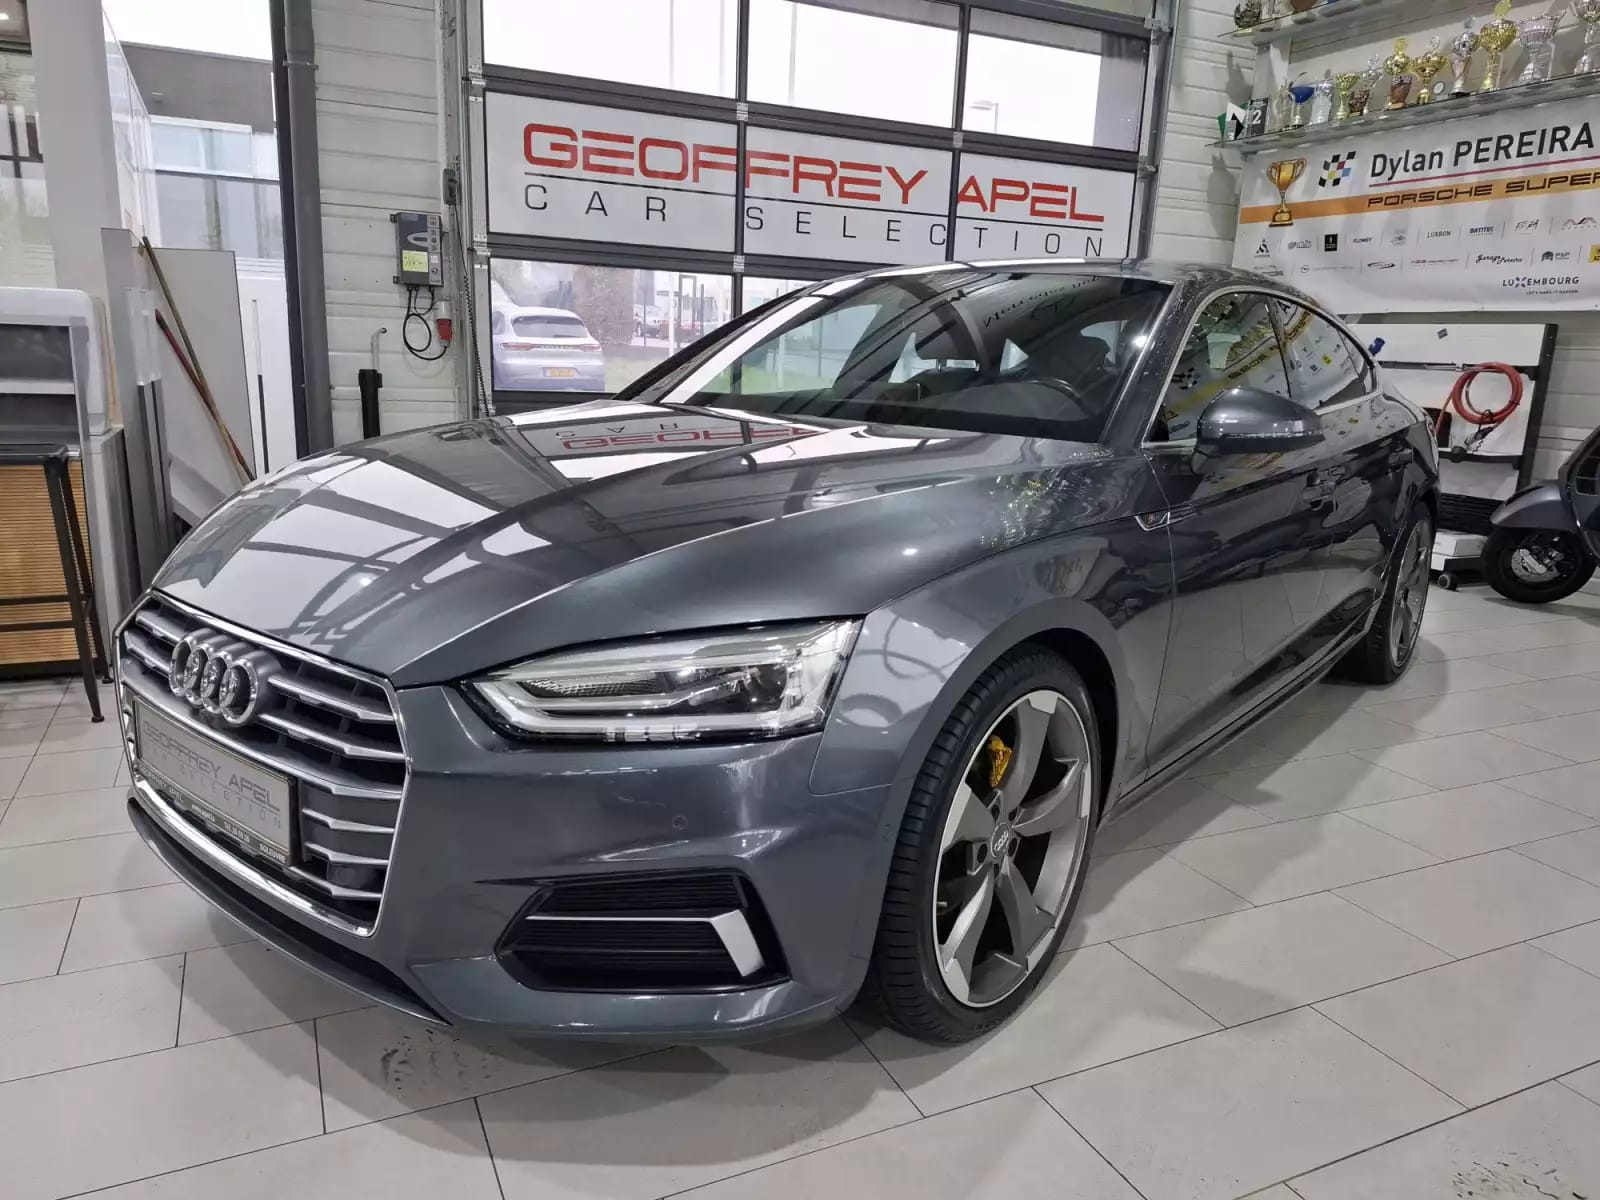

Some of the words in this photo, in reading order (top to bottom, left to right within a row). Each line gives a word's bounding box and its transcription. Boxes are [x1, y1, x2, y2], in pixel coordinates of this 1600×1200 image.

[523, 123, 929, 205] GEOFFREY
[958, 176, 1105, 222] APEL
[1370, 149, 1444, 181] Dylan
[1453, 122, 1595, 167] PEREIRA
[525, 183, 667, 222] CAR
[745, 206, 1104, 258] SELECTION
[1367, 184, 1493, 208] PORSCHE
[1502, 276, 1580, 289] LUXEMBOURG
[228, 773, 281, 813] APEL
